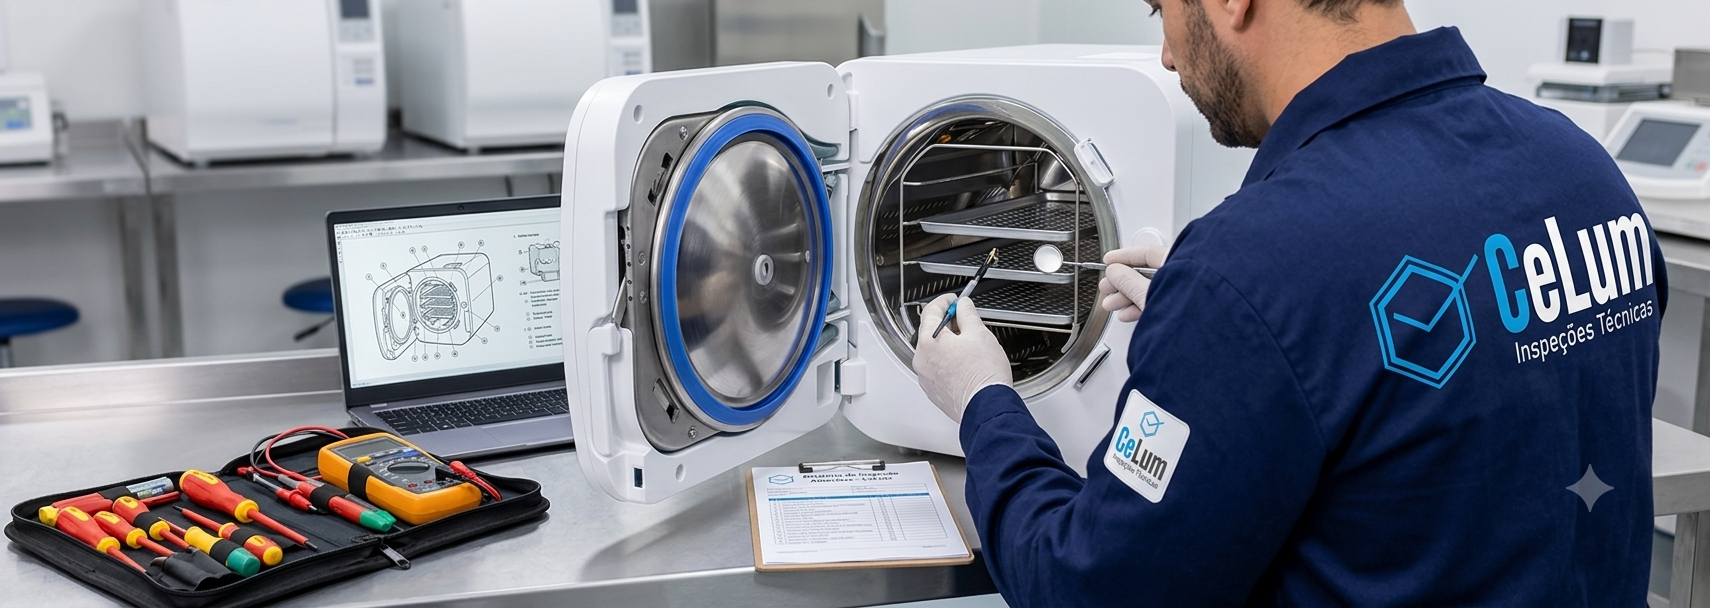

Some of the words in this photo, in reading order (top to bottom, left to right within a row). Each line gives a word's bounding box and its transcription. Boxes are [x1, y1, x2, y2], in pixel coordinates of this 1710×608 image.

[1484, 212, 1654, 334] CeLum
[1514, 322, 1595, 364] Inspeções
[1596, 300, 1654, 336] Técnicas
[1115, 426, 1168, 481] CeLum
